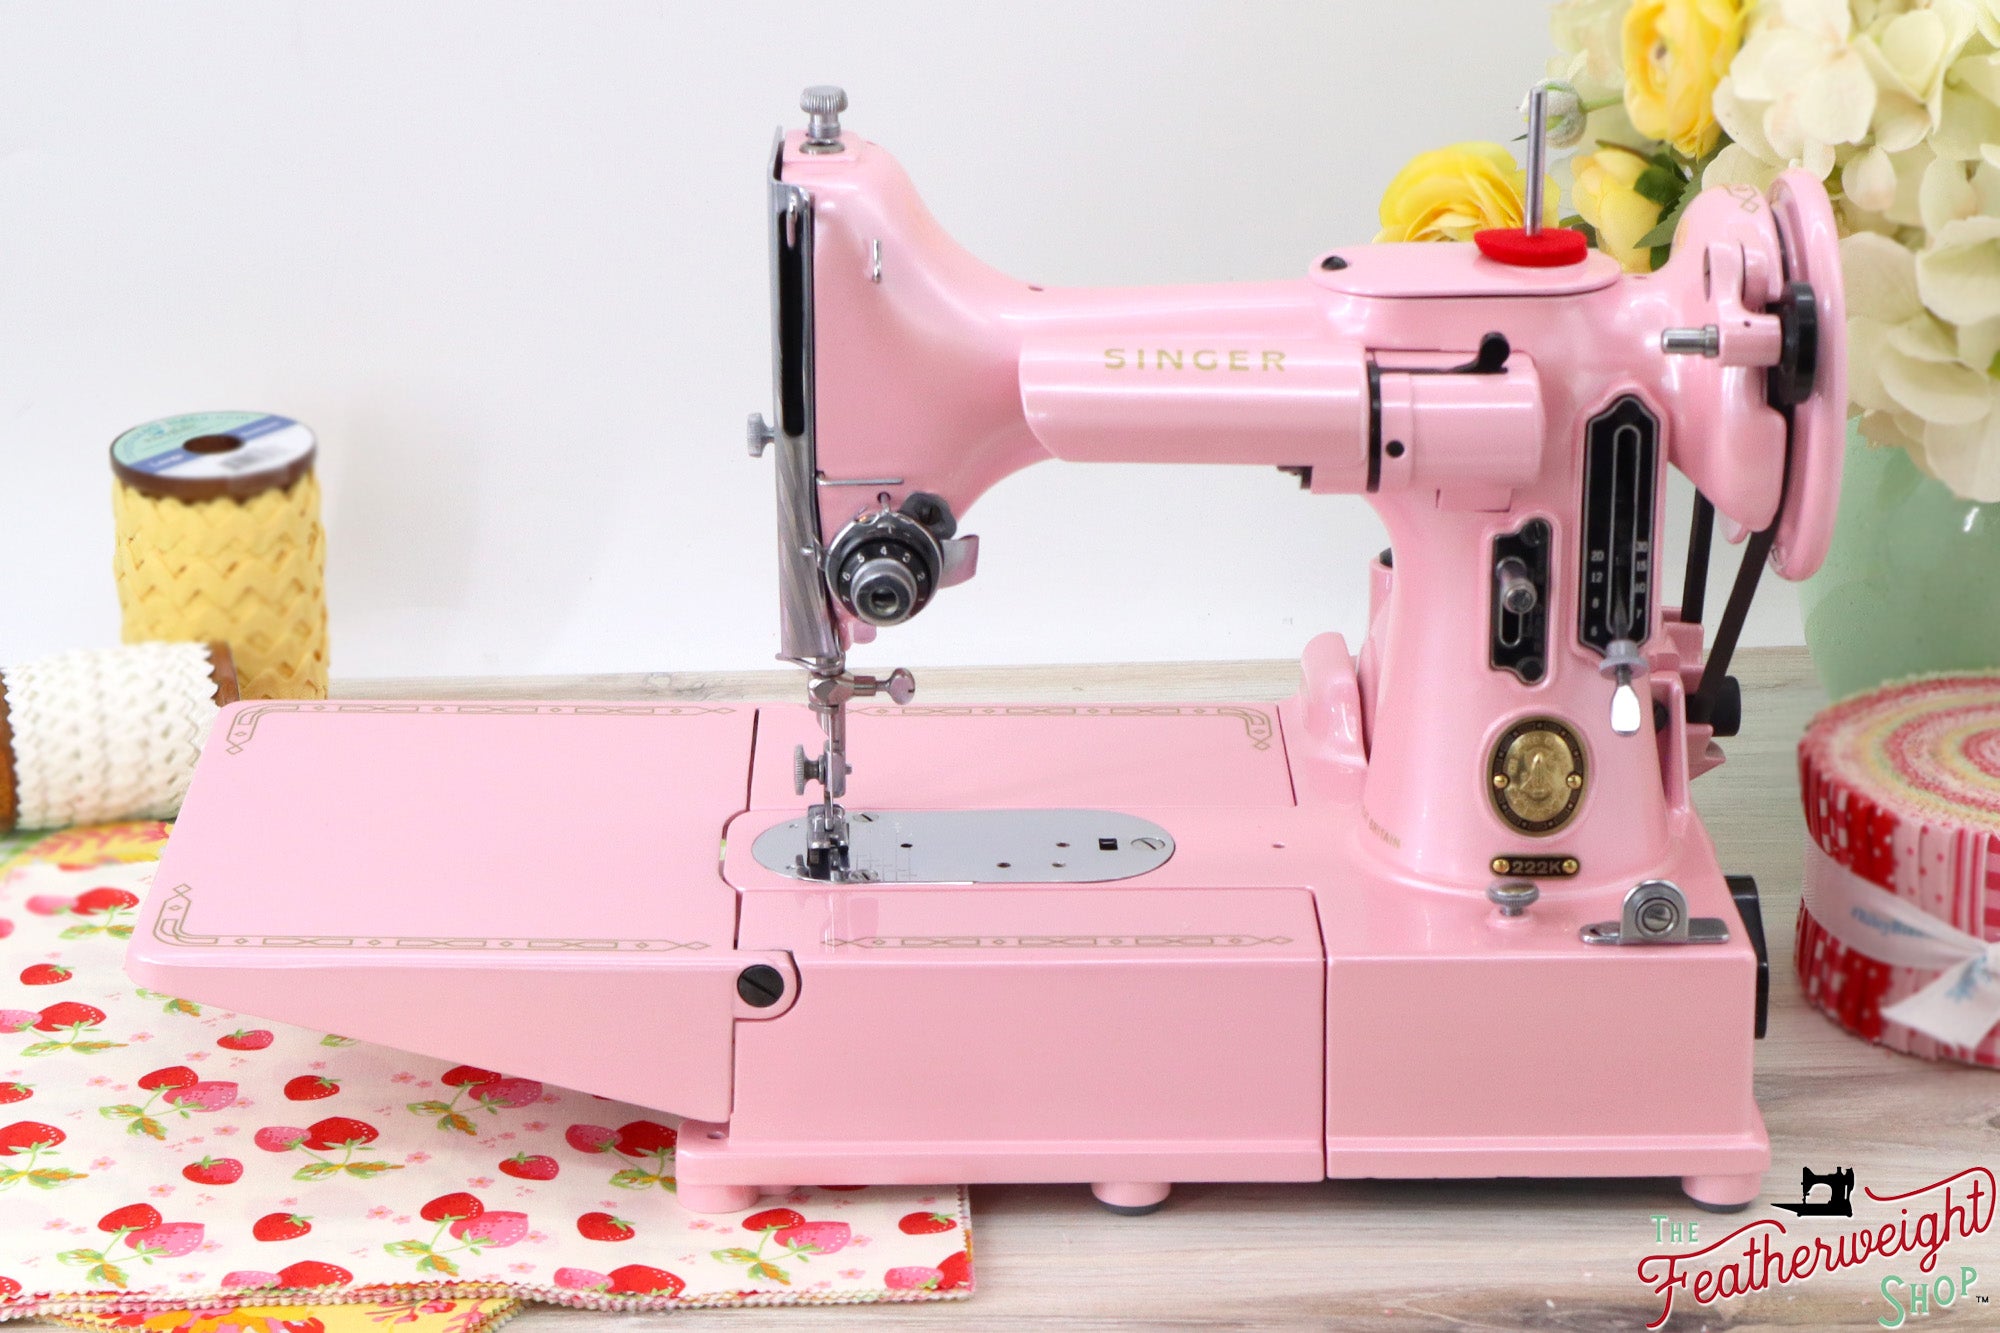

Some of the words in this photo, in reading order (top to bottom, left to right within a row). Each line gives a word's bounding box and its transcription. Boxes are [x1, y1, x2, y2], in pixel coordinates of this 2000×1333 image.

[1103, 348, 1287, 372] SINGER
[857, 552, 865, 563] 5
[880, 545, 887, 555] 4
[902, 552, 911, 563] 3
[1591, 550, 1604, 561] 20
[1512, 861, 1562, 874] 222K
